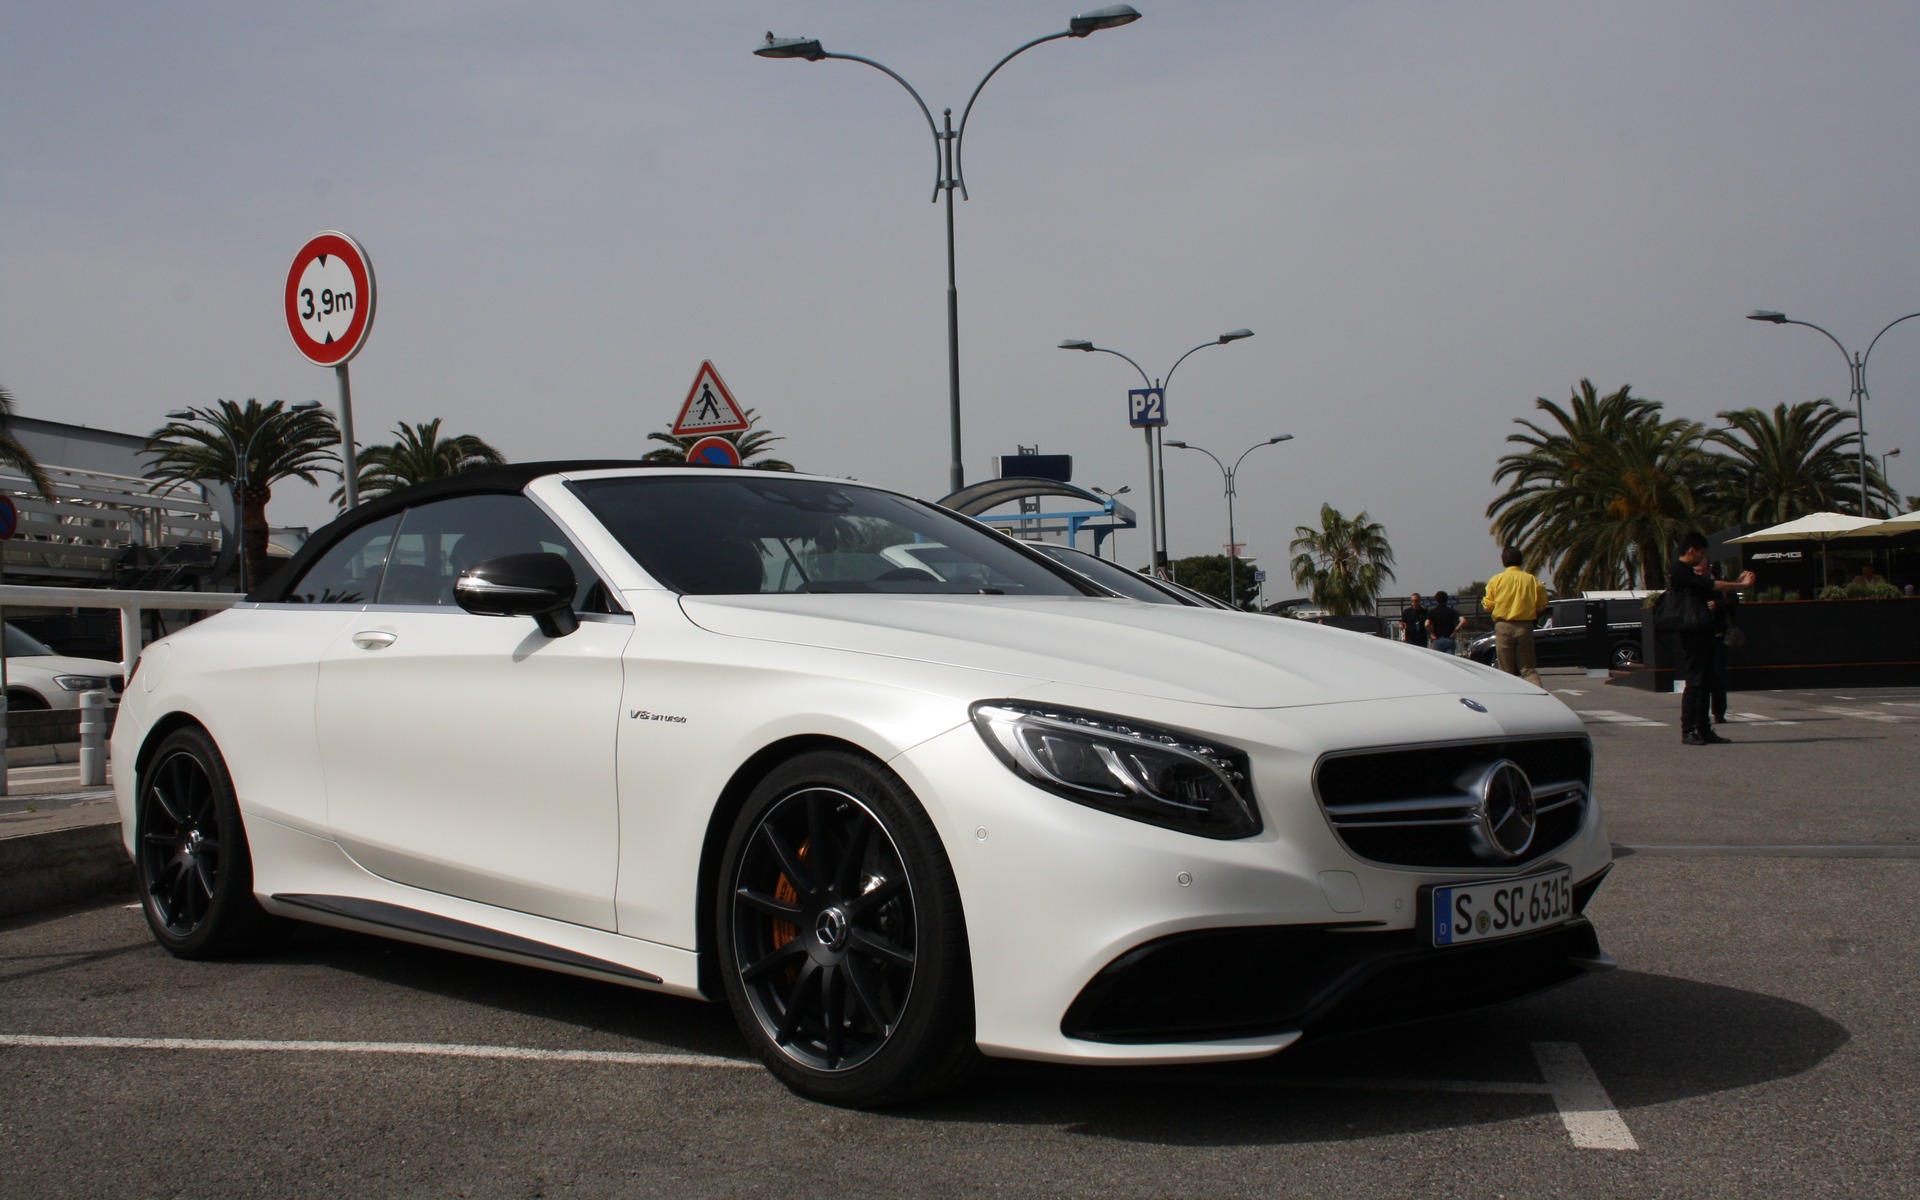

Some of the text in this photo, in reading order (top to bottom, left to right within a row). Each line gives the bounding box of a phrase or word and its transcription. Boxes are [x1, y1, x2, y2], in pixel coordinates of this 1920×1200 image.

[301, 288, 353, 322] 3,9m
[1131, 392, 1161, 420] P2
[1766, 551, 1802, 559] AMG
[630, 709, 650, 720] V8
[1440, 875, 1570, 935] D S SC 6315
